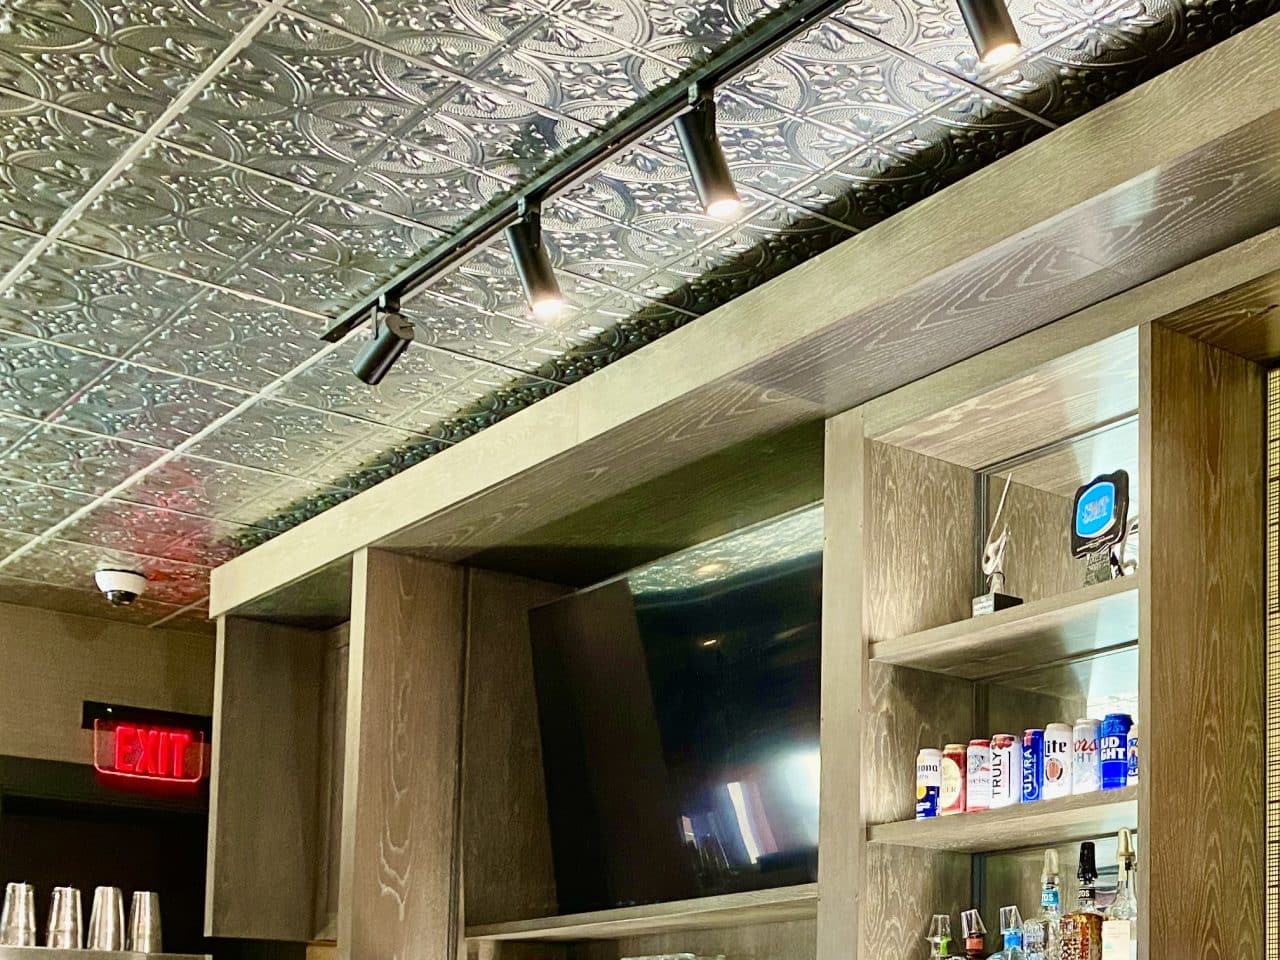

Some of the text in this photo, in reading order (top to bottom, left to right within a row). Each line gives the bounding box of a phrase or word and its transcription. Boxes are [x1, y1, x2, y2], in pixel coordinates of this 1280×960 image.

[1045, 740, 1067, 757] Lite
[1074, 738, 1098, 752] ors
[1101, 736, 1120, 748] UD
[115, 726, 192, 778] EXIT
[1101, 747, 1125, 760] GHT
[918, 764, 938, 772] rona
[992, 752, 1002, 798] TRULY
[1024, 748, 1033, 793] ULTRA
